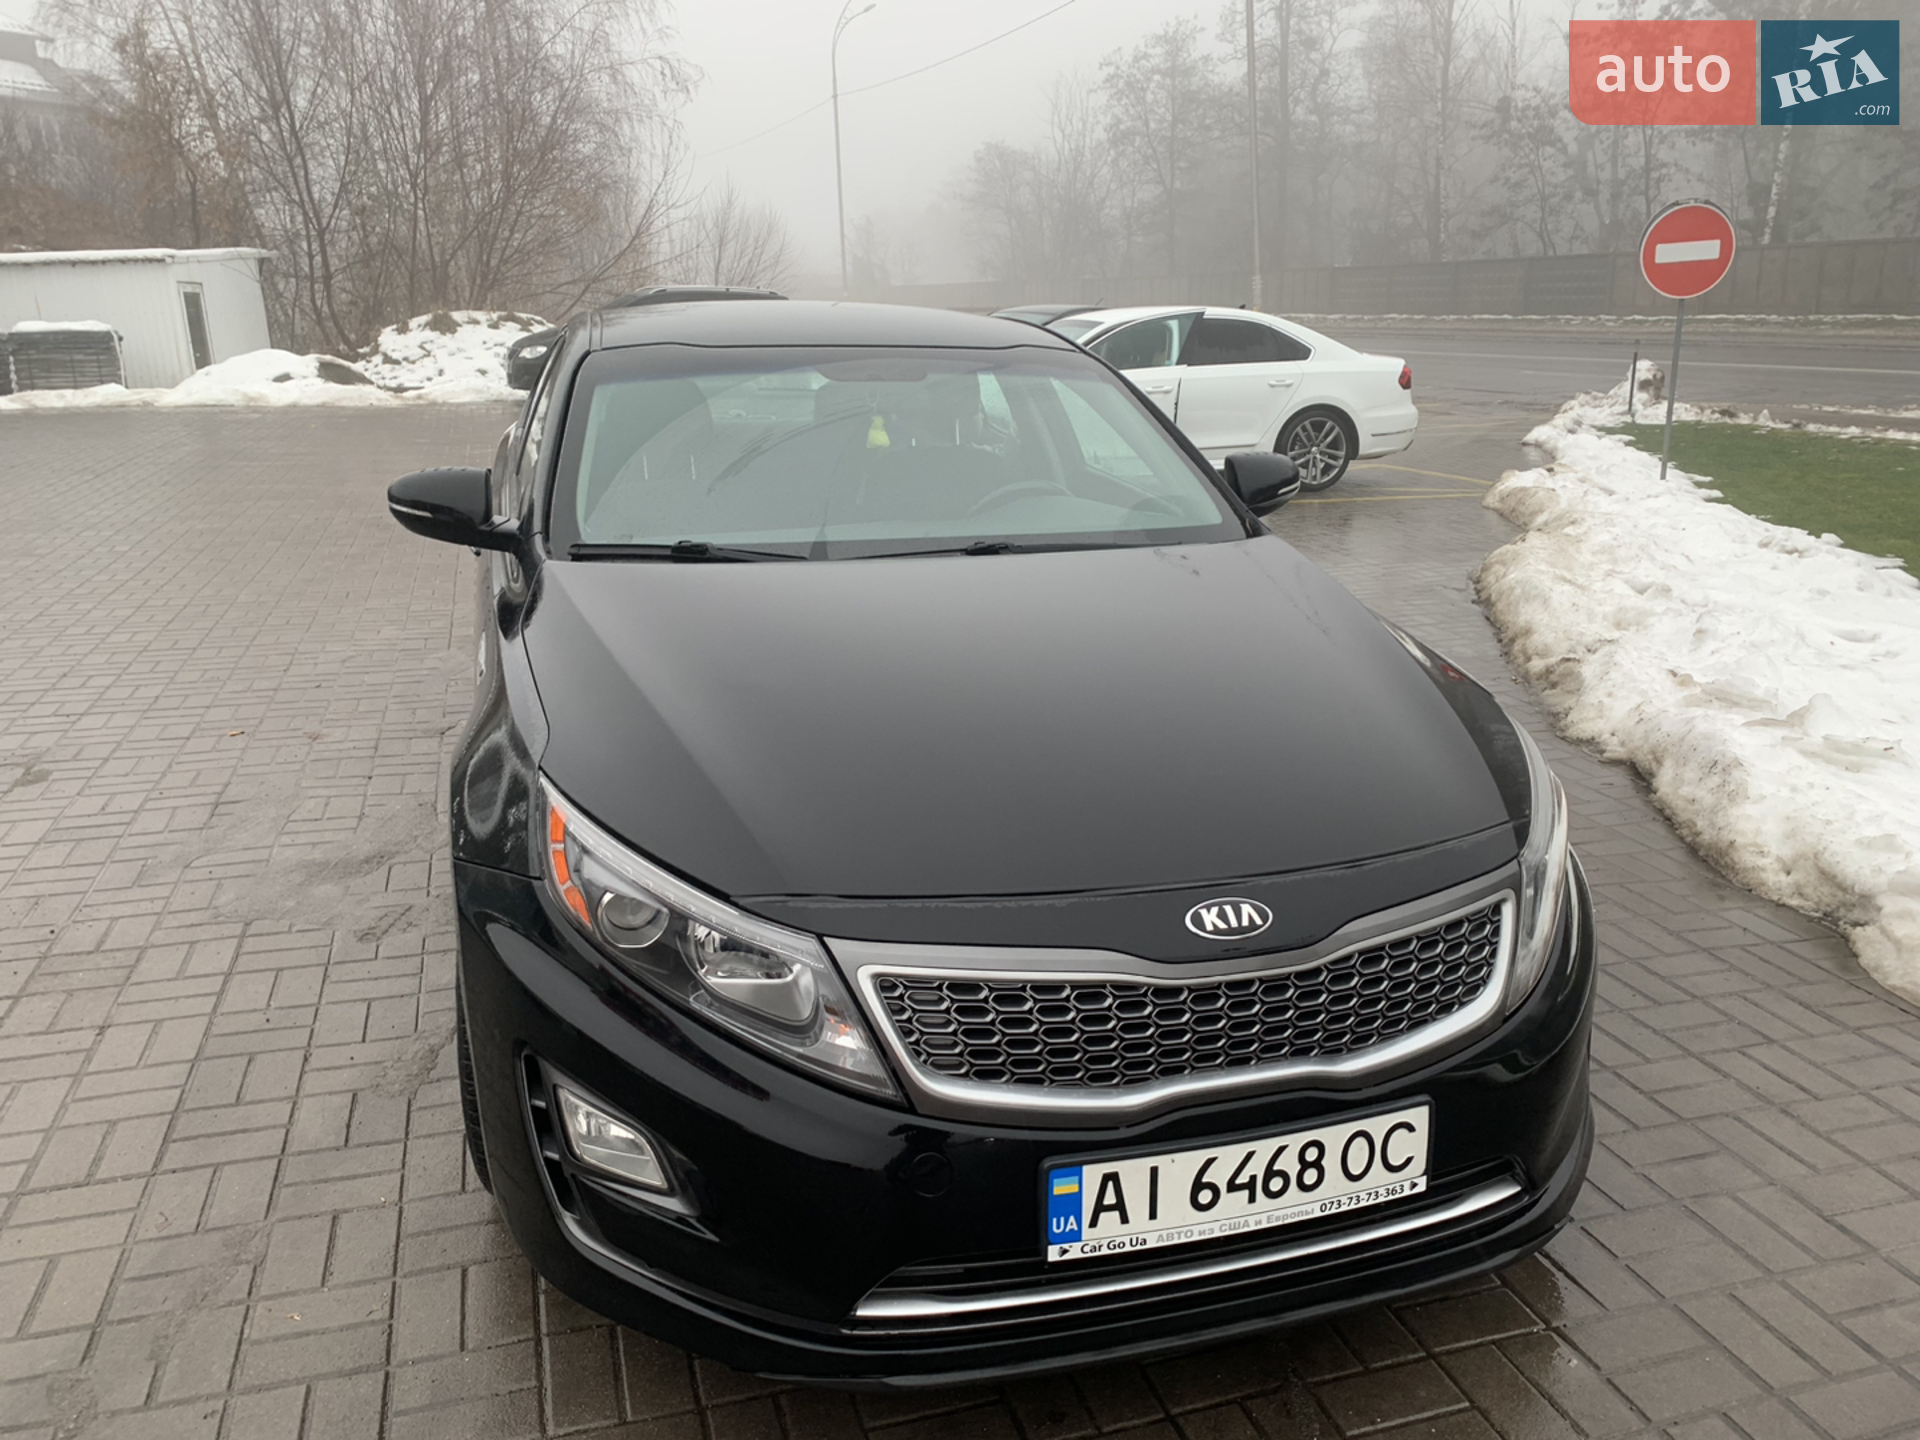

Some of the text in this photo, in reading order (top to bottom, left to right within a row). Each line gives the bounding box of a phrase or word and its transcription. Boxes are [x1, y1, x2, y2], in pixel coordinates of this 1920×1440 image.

[1196, 903, 1264, 932] KIA
[1088, 1121, 1416, 1228] AI 6468 OC
[1052, 1216, 1078, 1234] UA
[1080, 1184, 1405, 1255] Car Go Ua АВТО из США и Европы 073-73-73-363
